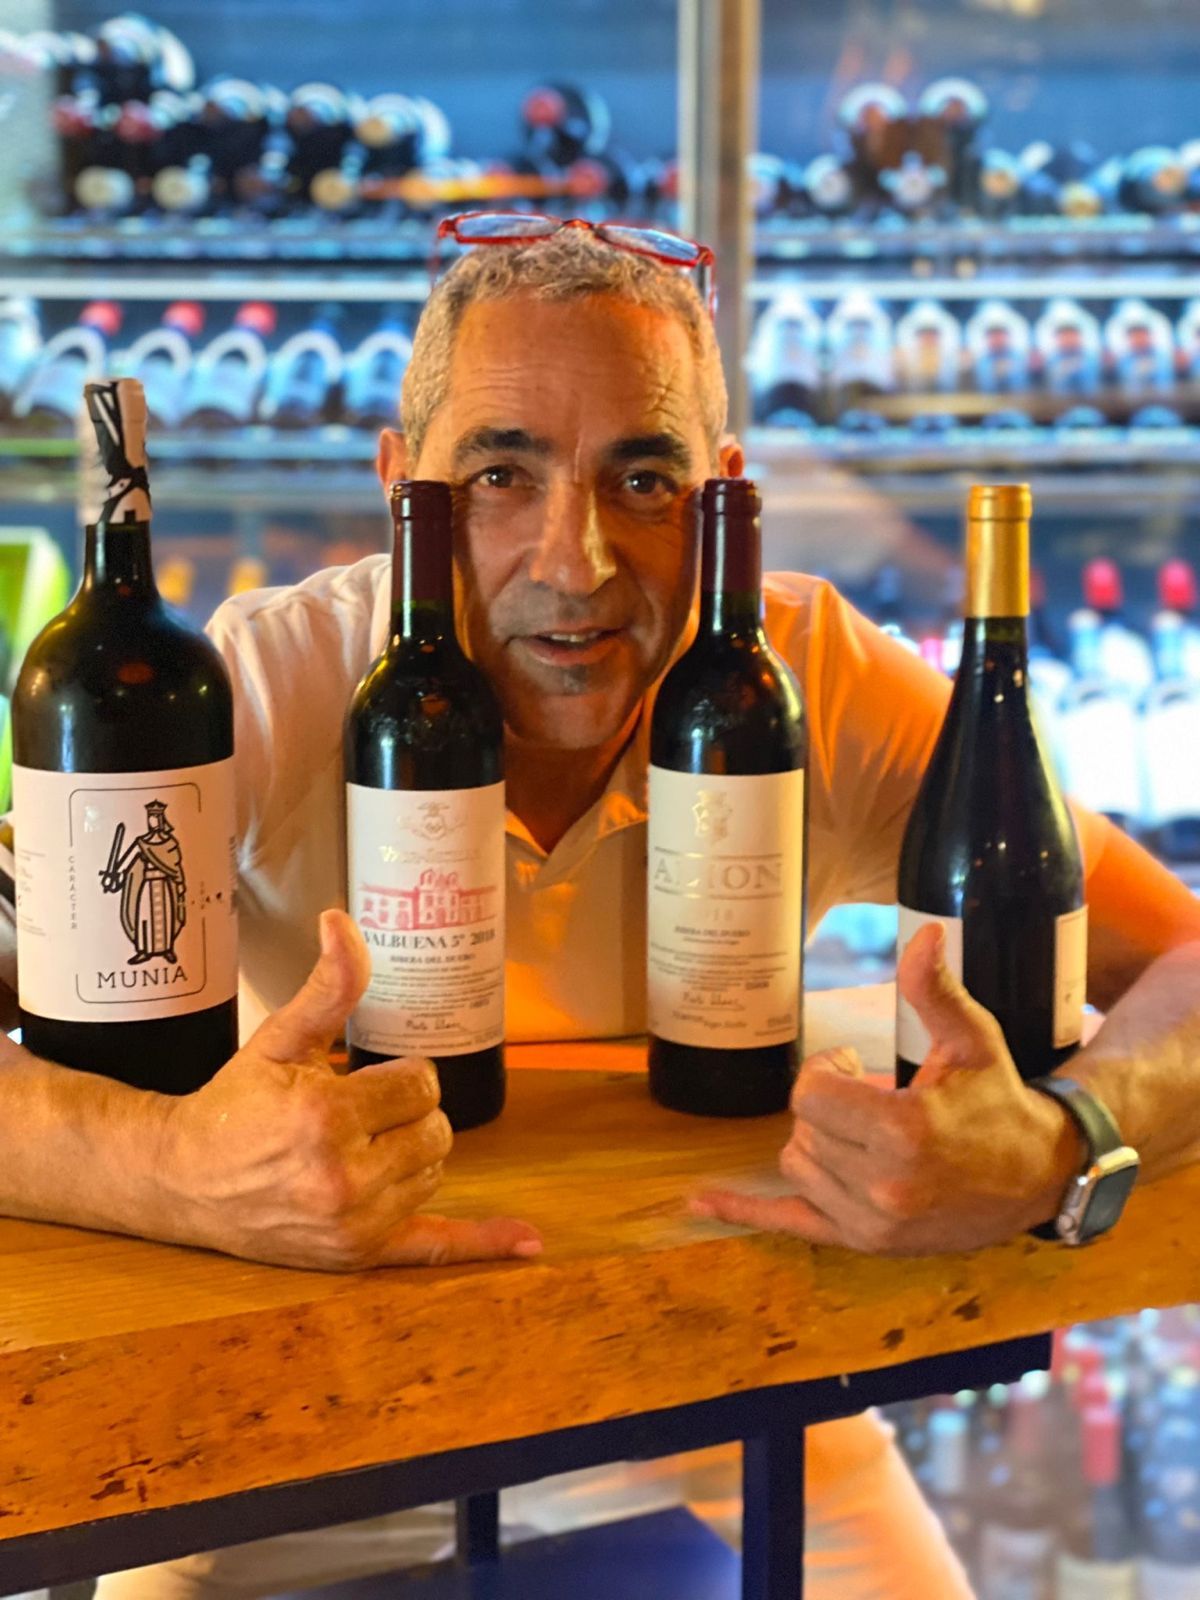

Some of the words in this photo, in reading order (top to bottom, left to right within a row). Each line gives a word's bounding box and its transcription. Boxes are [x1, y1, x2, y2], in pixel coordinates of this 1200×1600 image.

[67, 855, 79, 930] CARACTER
[363, 930, 447, 949] VALBUENA
[96, 965, 189, 989] MUNIA
